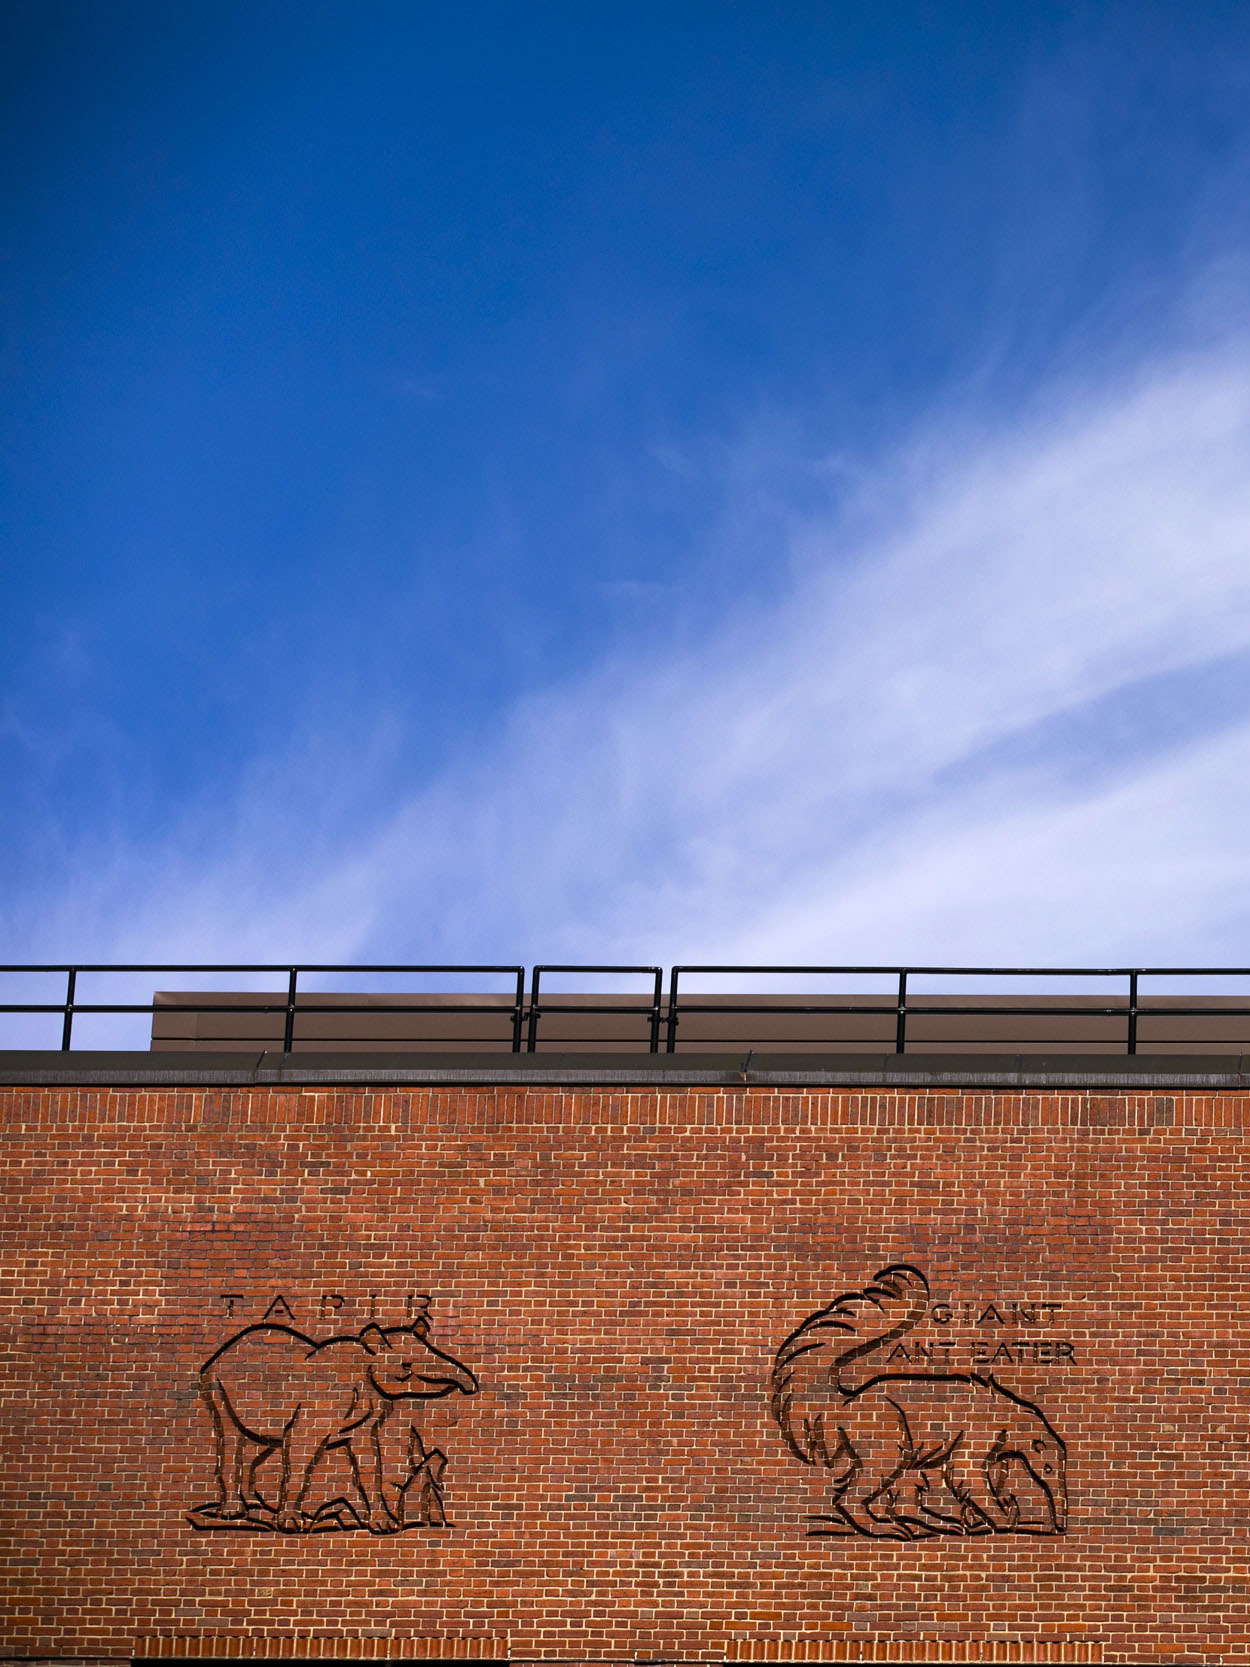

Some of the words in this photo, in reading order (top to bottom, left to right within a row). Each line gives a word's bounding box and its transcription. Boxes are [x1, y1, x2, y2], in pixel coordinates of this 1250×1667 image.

[219, 1294, 433, 1321] TAPIR
[931, 1303, 1063, 1325] GIANT
[886, 1342, 956, 1364] ANT
[970, 1342, 1077, 1366] EATER
